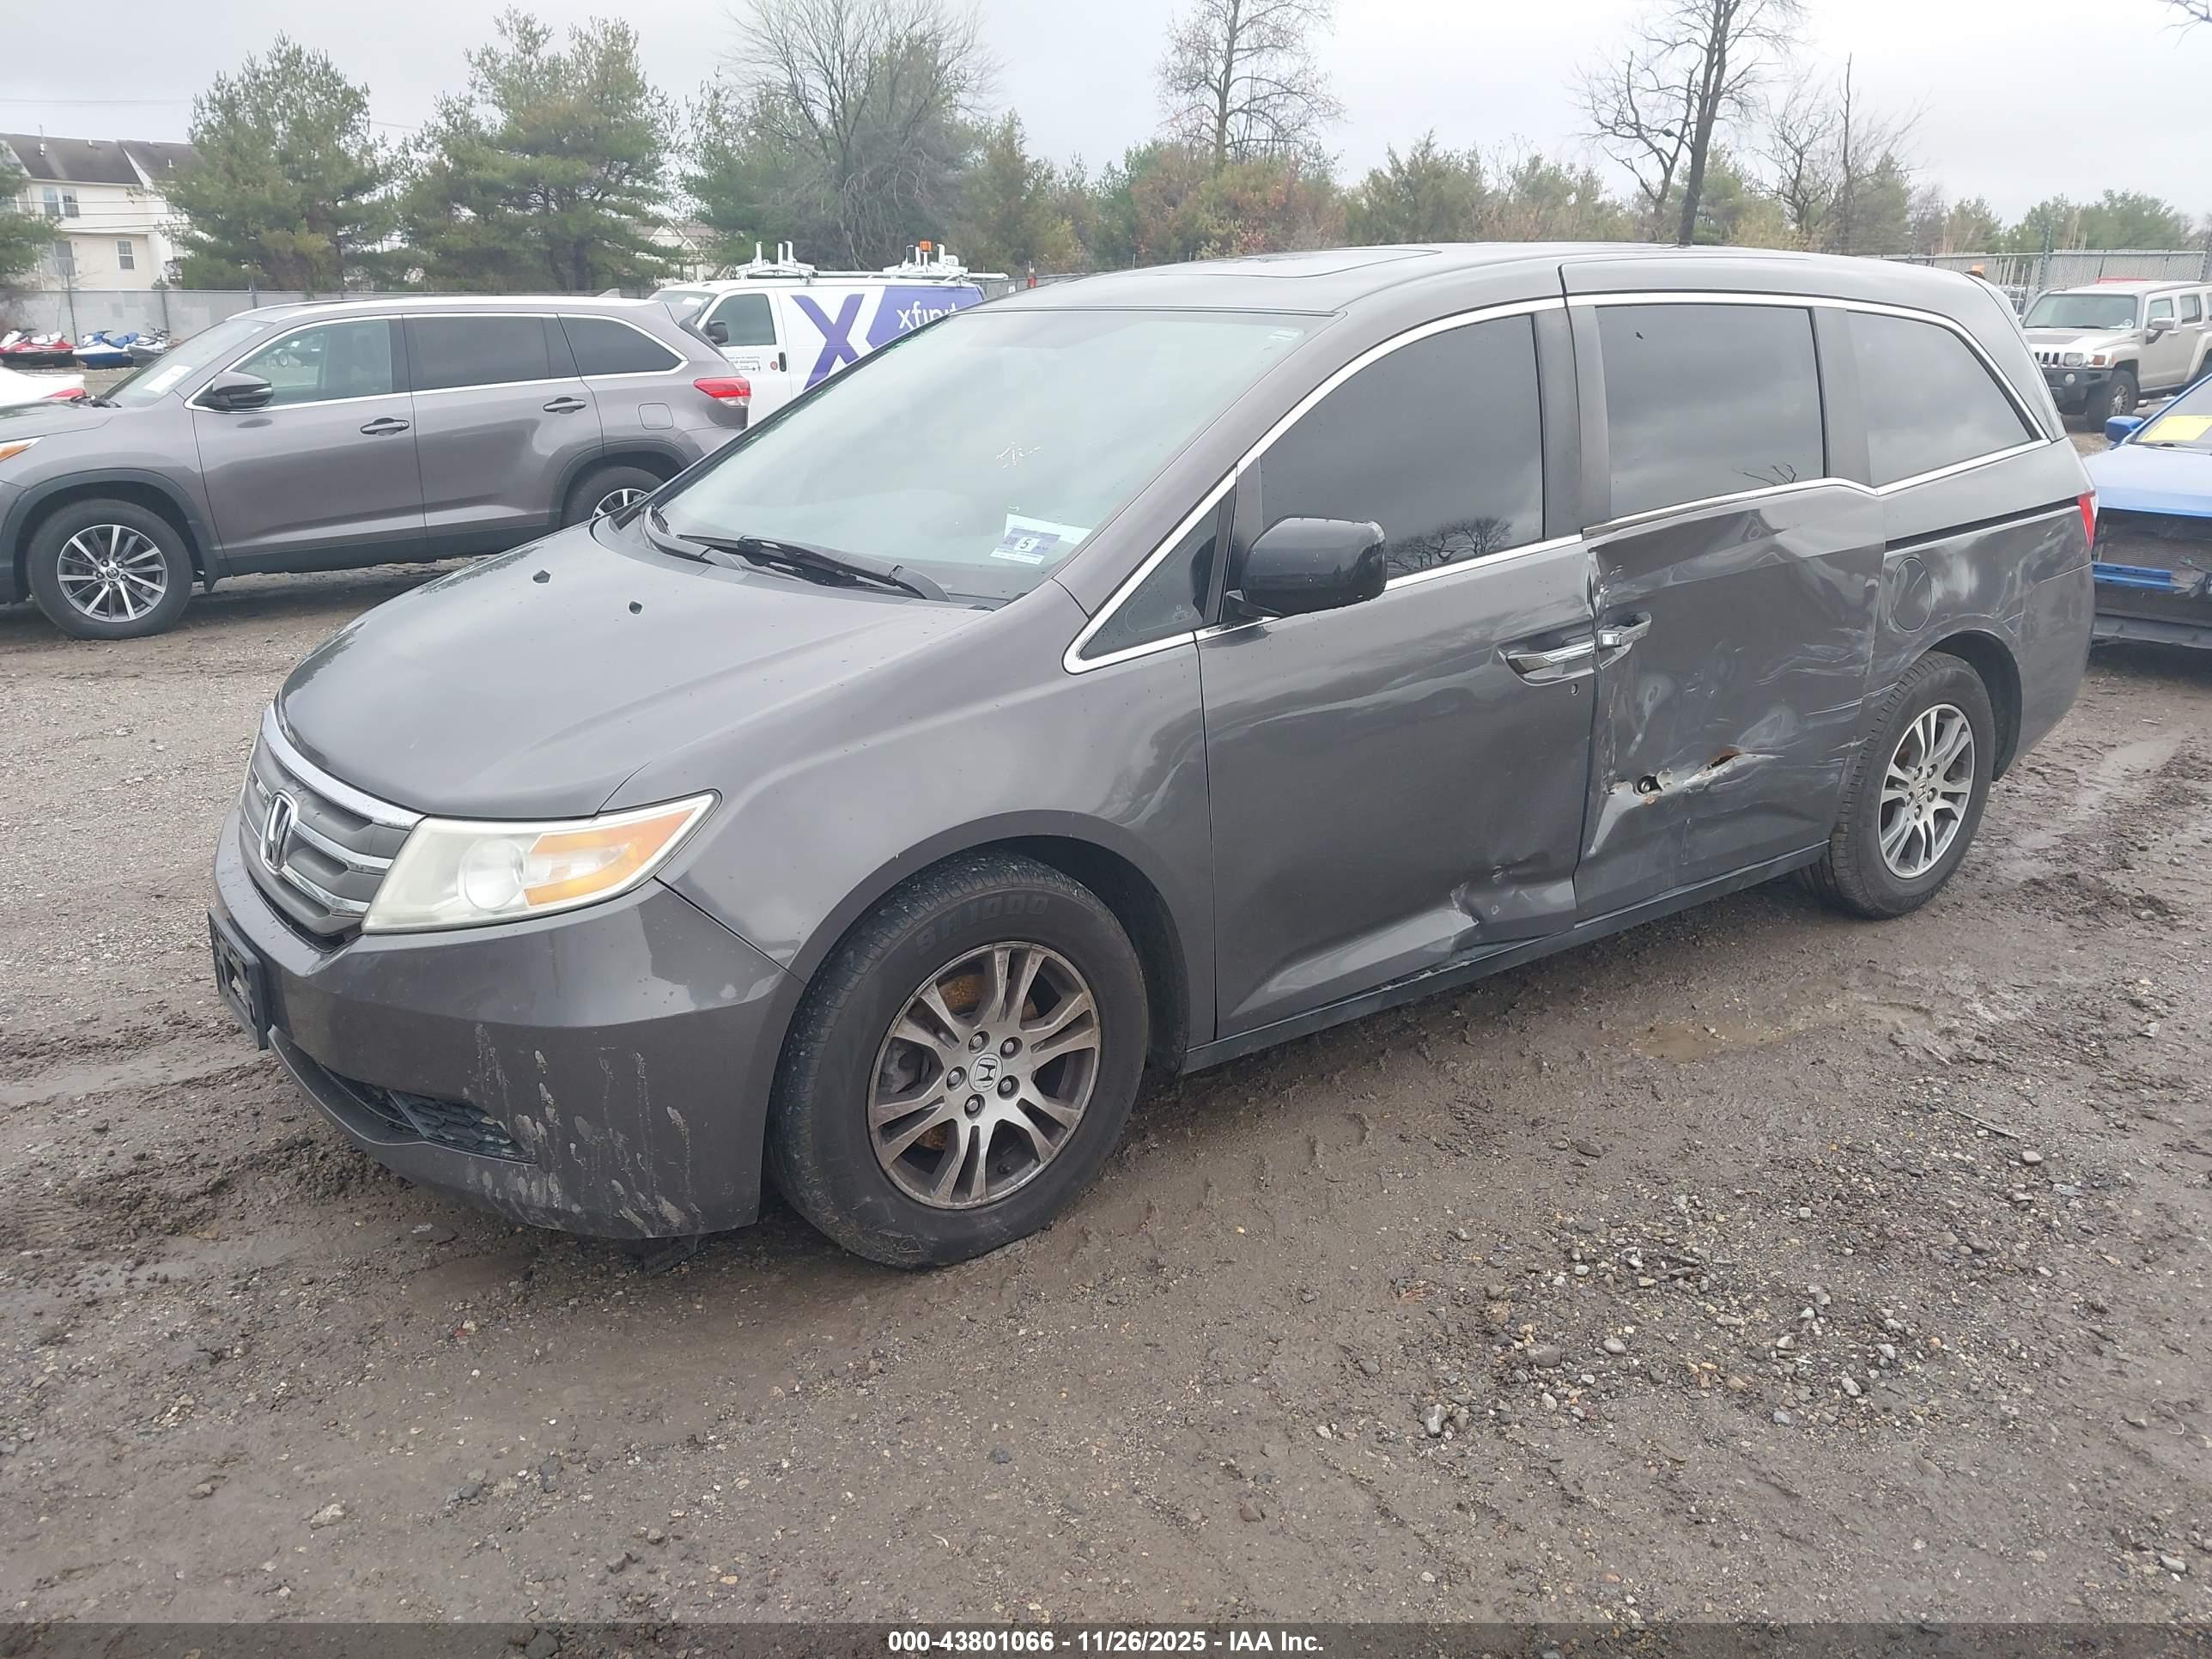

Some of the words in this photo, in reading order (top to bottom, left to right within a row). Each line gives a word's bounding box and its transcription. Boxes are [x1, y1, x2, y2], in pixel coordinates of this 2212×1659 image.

[896, 301, 957, 330] xfin
[790, 294, 865, 392] X
[1019, 538, 1033, 550] 5
